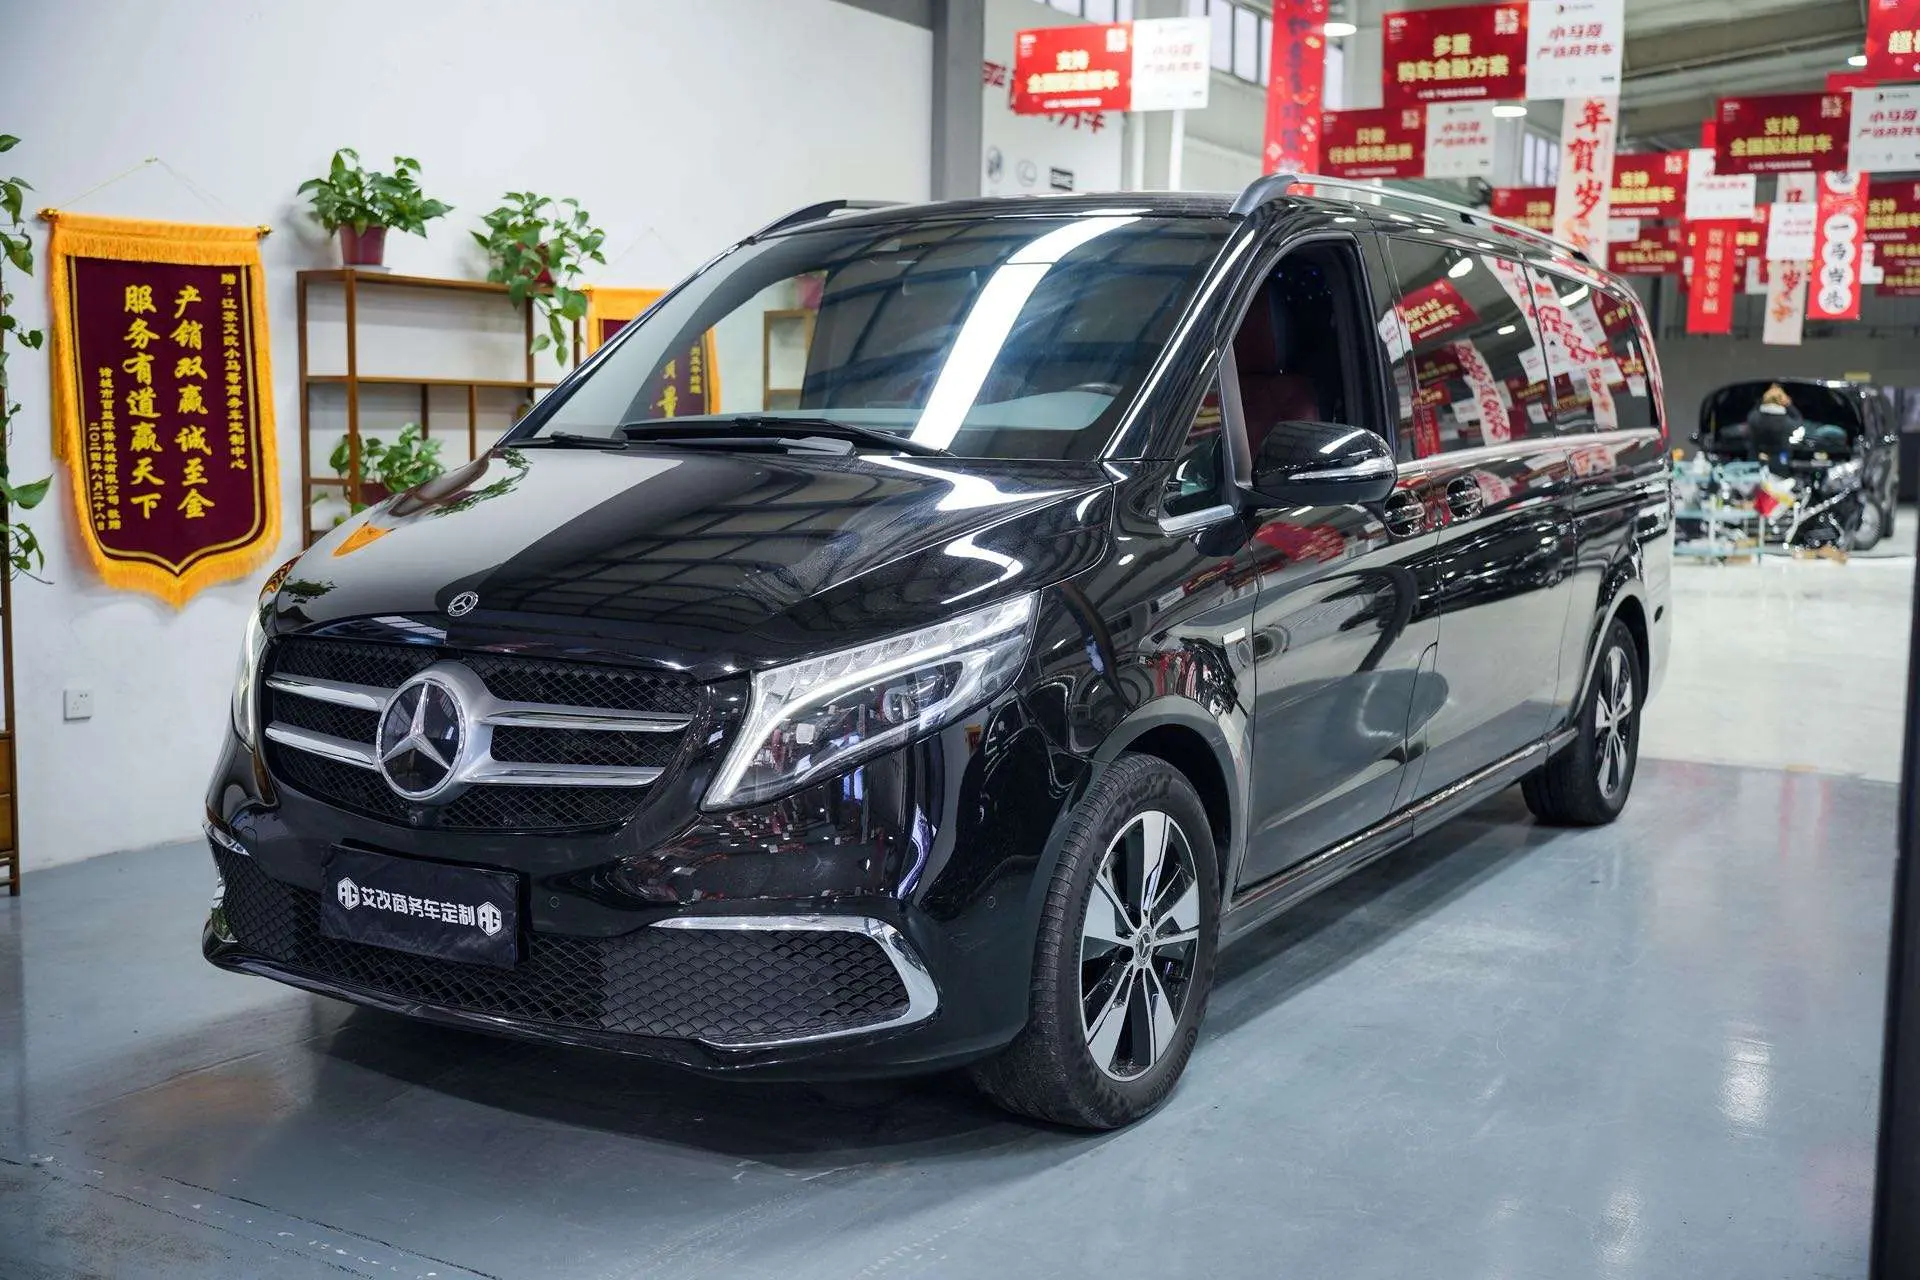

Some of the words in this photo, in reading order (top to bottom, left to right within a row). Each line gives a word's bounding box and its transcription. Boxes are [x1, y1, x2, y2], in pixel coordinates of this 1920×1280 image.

[1764, 115, 1800, 135] 支持
[122, 284, 166, 519] 服务有道赢天下
[169, 284, 216, 519] 产销双赢诚至金
[361, 886, 476, 927] 艾改商务车定制
